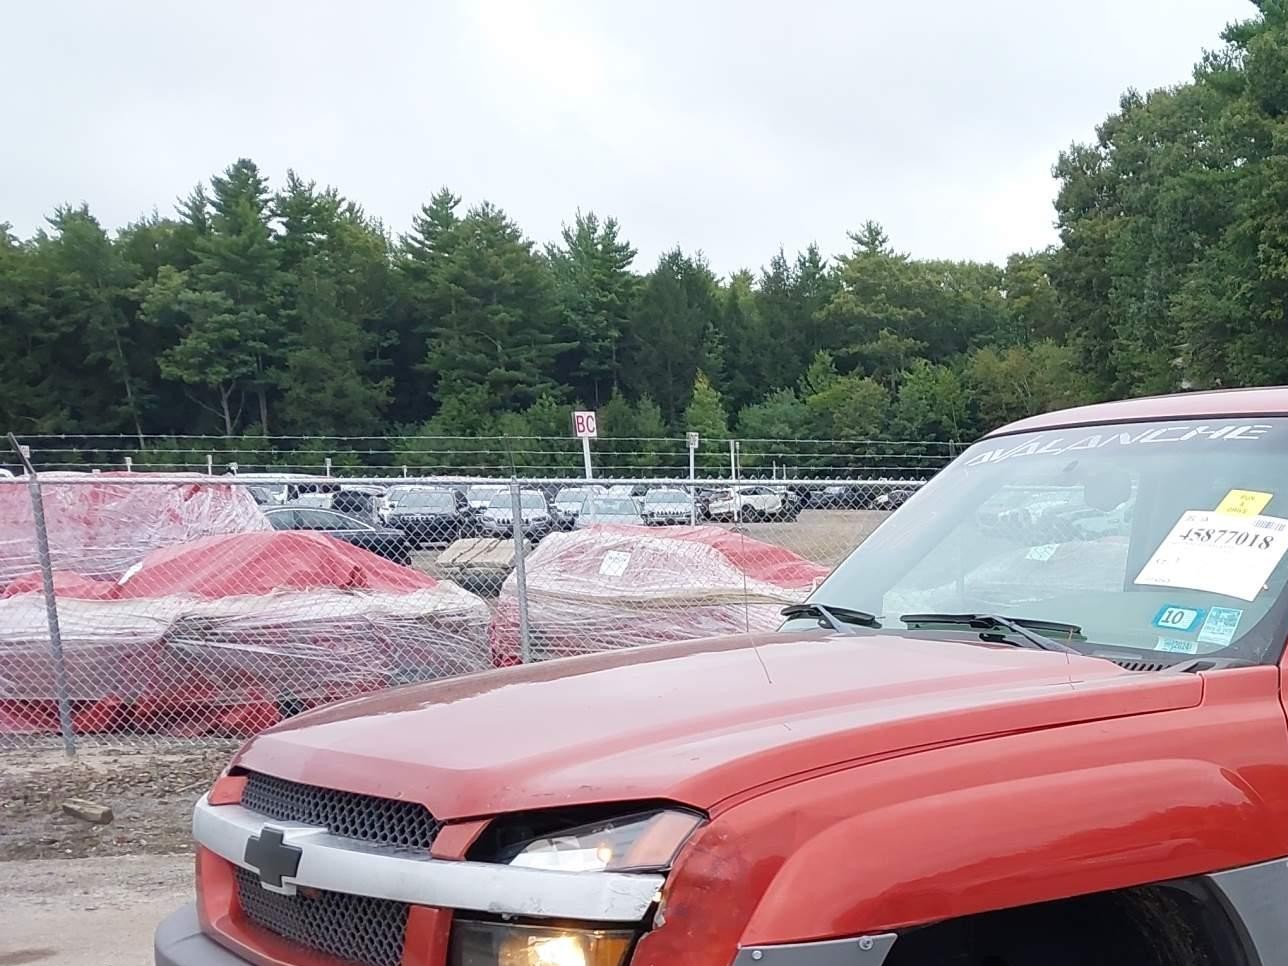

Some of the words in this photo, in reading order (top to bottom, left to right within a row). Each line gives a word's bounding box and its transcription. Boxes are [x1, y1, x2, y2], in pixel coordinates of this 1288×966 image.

[576, 415, 596, 433] BC
[966, 425, 1273, 466] AVALANCHE
[1179, 527, 1275, 551] 45877018
[1161, 609, 1185, 625] 10
